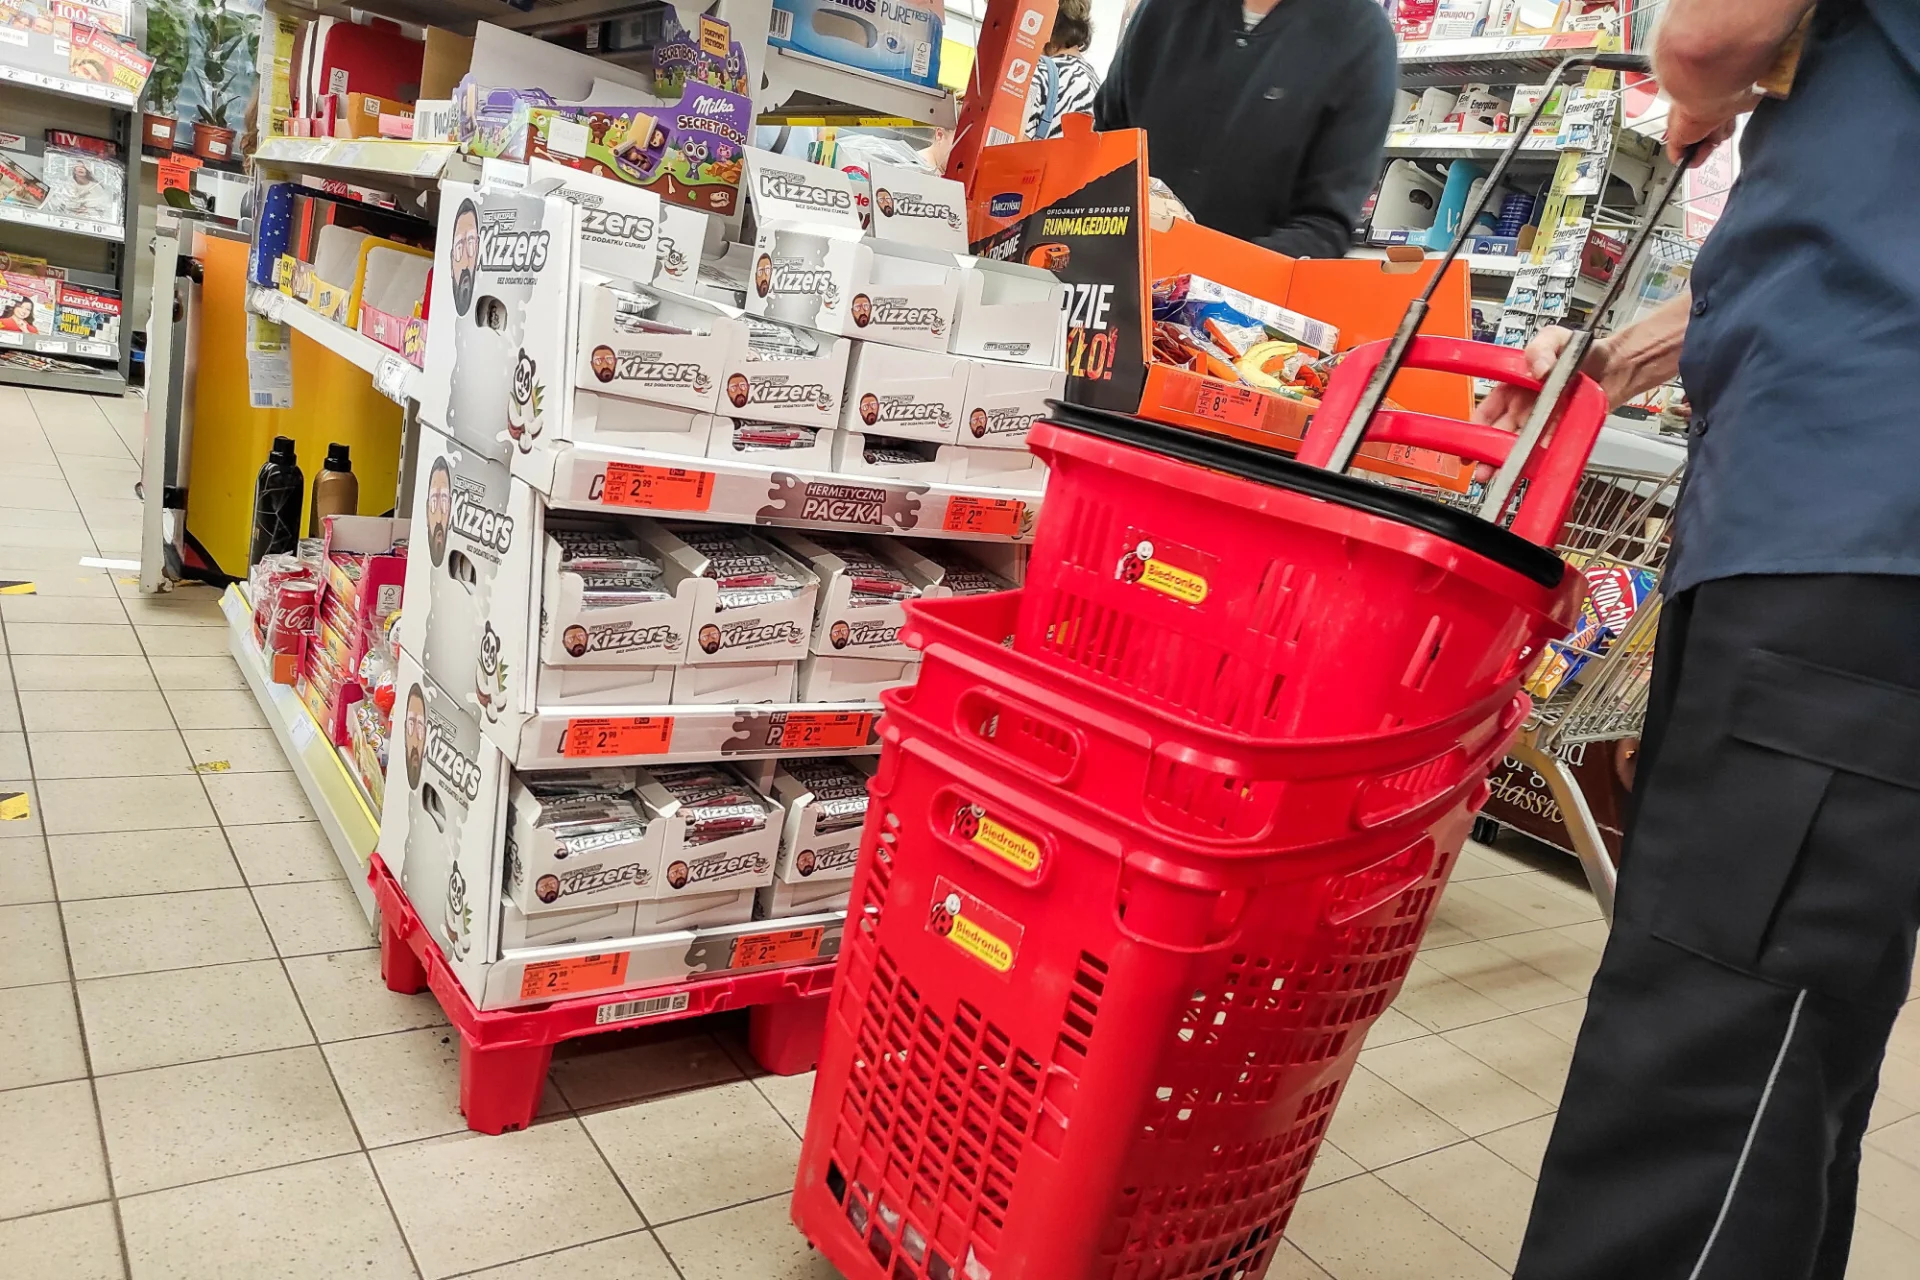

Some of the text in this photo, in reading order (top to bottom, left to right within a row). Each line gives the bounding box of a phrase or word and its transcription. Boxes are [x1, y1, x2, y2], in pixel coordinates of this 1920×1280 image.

[880, 3, 912, 26] PURE
[1440, 10, 1476, 20] Cholinex
[658, 43, 698, 66] SECRET BOX
[1506, 41, 1515, 50] 9
[92, 39, 148, 75] GAZETA POLSKA
[692, 94, 736, 117] Milka
[1470, 99, 1500, 112] Energizer
[1565, 99, 1608, 115] Energizer
[58, 132, 77, 146] TV
[677, 115, 746, 147] SECRET BOX
[760, 174, 851, 209] Kizzers
[892, 196, 951, 220] Kizzers
[1046, 205, 1131, 216] OFICJALNY SPONSOR
[581, 206, 655, 241] zzers
[1042, 215, 1129, 237] RUNMAGEDDON
[1552, 225, 1589, 239] Energizer
[476, 220, 550, 272] Kizzers
[592, 235, 624, 246] DODATKU
[624, 239, 646, 250] CUKRU
[770, 265, 832, 294] Kizzers
[1516, 265, 1551, 277] Energizer
[63, 295, 119, 312] GAZETA POLSKA
[870, 301, 938, 326] Kizzers
[613, 355, 701, 382] Kizzers
[747, 380, 823, 405] Kizzers
[877, 400, 944, 422] Kizzers
[1212, 396, 1221, 412] 8
[984, 412, 1046, 434] Kizzer
[1404, 446, 1412, 459] 8
[630, 478, 641, 496] 2
[642, 479, 652, 488] 99
[808, 484, 887, 501] HERMETYCZNA
[449, 488, 515, 555] Kizzers
[801, 499, 883, 523] PACZKA
[966, 509, 975, 525] 2
[560, 540, 617, 551] izzers
[711, 556, 762, 567] izzers
[714, 563, 776, 577] Kizzers
[1147, 564, 1203, 593] Biedronka
[720, 590, 785, 609] Kizzers
[586, 624, 670, 653] Kizzers
[719, 620, 795, 650] Kizzers
[596, 731, 607, 748] 2
[803, 727, 813, 741] 2
[423, 721, 482, 802] Kizzers
[813, 786, 866, 801] Kizzers
[692, 804, 755, 821] Kizzers
[823, 799, 868, 817] Kizzer
[565, 829, 633, 854] Kizzers
[982, 822, 1036, 861] Biedronka
[686, 851, 760, 884] Kizzers
[812, 847, 860, 873] Kizze
[558, 862, 640, 898] Kizzers
[955, 920, 1008, 961] Biedronka
[758, 946, 768, 960] 2
[547, 972, 558, 987] 2
